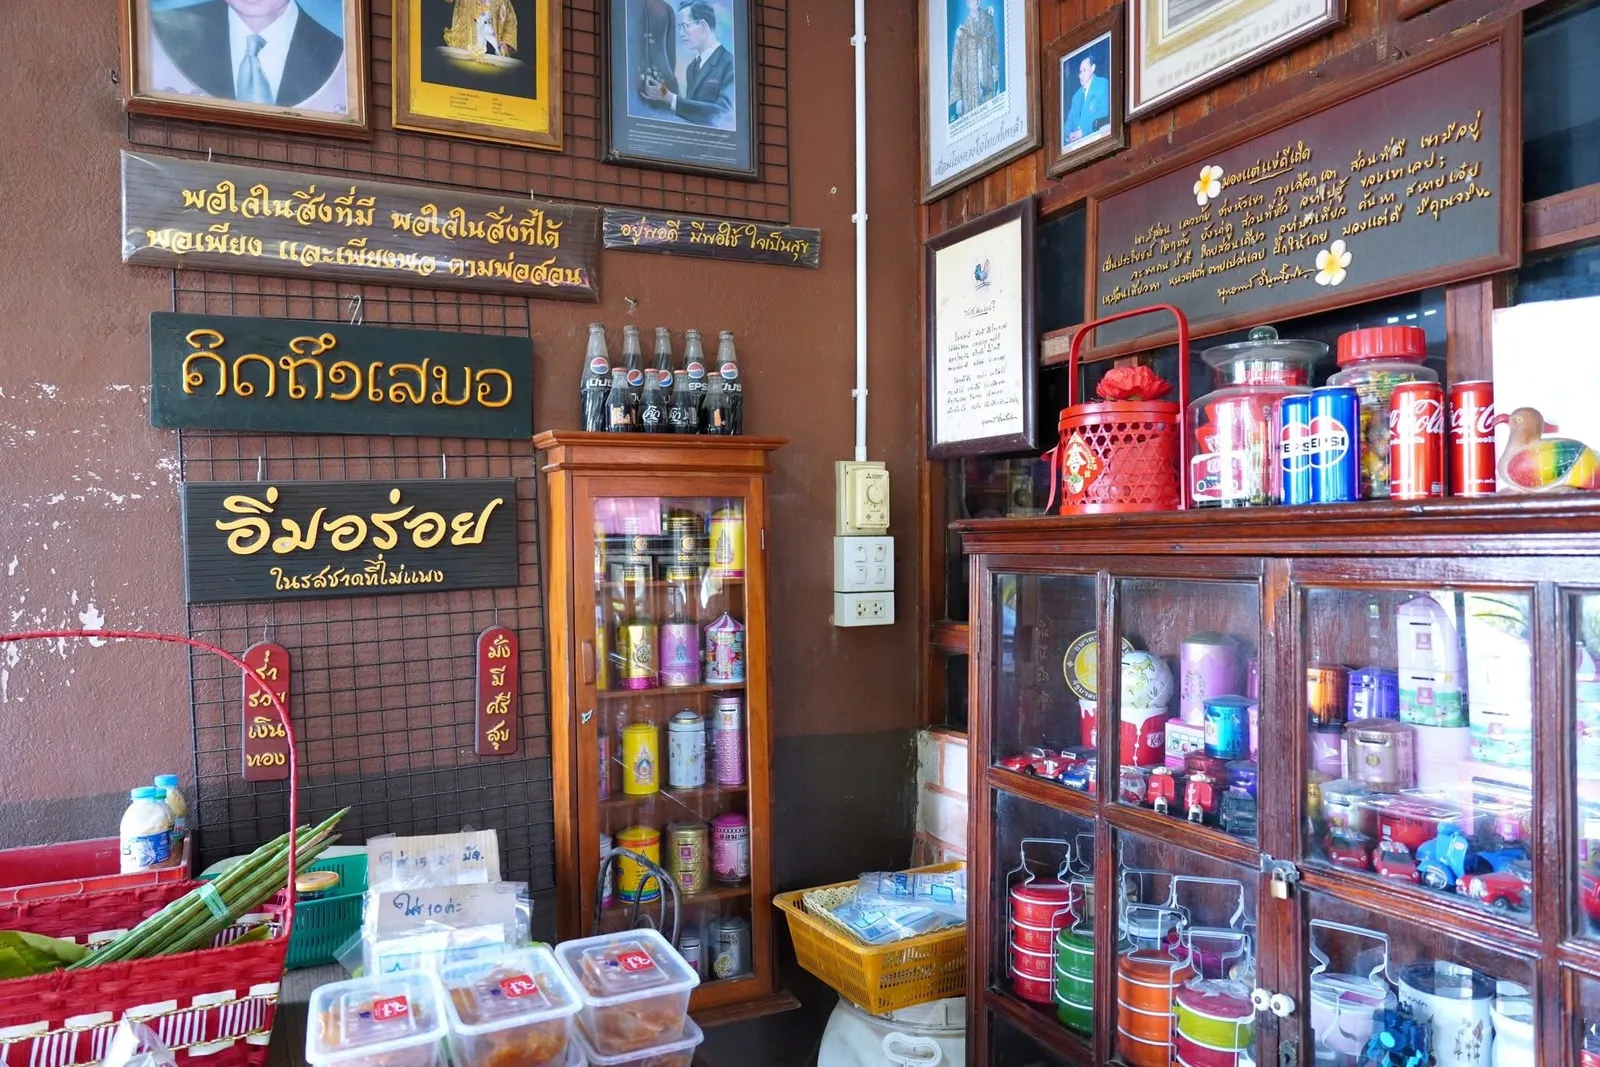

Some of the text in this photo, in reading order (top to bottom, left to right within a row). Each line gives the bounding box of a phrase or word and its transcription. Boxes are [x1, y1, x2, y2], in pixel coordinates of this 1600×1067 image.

[182, 179, 563, 249] พอใจในสิ่งที่มี พอใจในสิ่งที่ได้
[146, 222, 583, 287] พอเพียง และเพียงพอ ตามพ่อสอน
[620, 216, 810, 262] อยู่พอดี มีพอใช้ ใจเป็นสุข
[182, 328, 514, 409] คิดถึงเสมอ
[1311, 436, 1346, 448] EPSI
[215, 486, 503, 555] อิ่มอร่อย
[269, 553, 444, 590] ในรสชาดที่ไม่แพง
[491, 665, 506, 687] มี
[486, 692, 512, 715] ศรี
[249, 716, 286, 739] เงิน
[485, 720, 510, 750] สุข
[246, 752, 286, 767] ทอง
